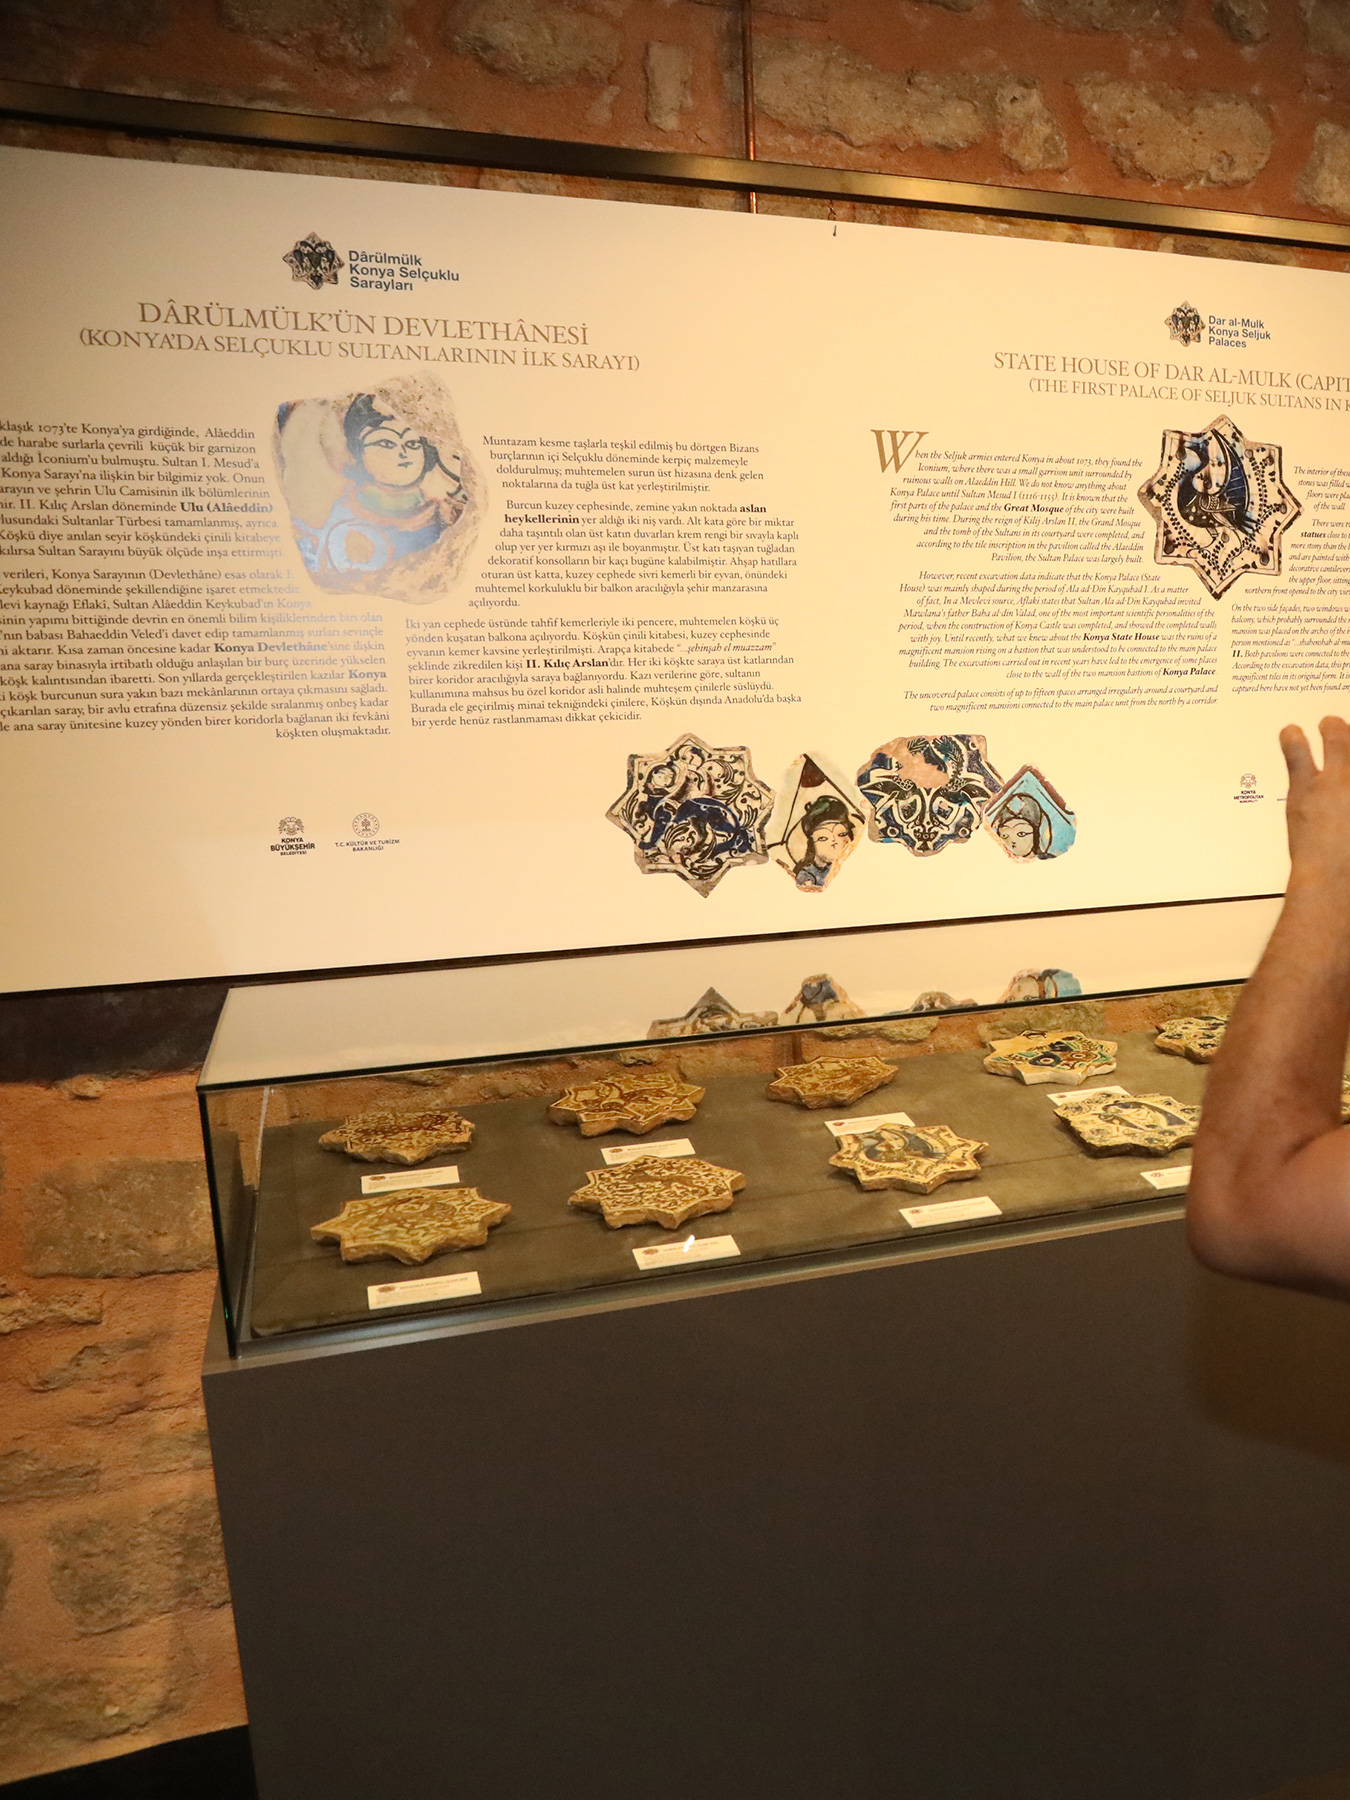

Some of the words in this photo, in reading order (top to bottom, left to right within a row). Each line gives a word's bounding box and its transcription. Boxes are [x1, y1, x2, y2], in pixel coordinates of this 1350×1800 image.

[348, 250, 422, 266] Dârülmülk
[349, 264, 396, 280] Konya
[398, 266, 460, 283] Selçuklu
[349, 276, 414, 292] Sarayları
[383, 314, 590, 346] DEVLETHÂNESİ
[1208, 314, 1226, 326] Dar
[1228, 317, 1264, 330] al-Mulk
[1208, 326, 1239, 339] Konya
[1241, 328, 1272, 342] Seljuk
[1208, 336, 1246, 348] Palaces
[214, 335, 332, 358] SELÇUKLU
[337, 342, 517, 366] SULTANLARININ
[523, 347, 558, 369] İLK
[562, 351, 641, 373] SARAYI)
[993, 352, 1057, 373] STATE
[1061, 357, 1130, 378] HOUSE
[1134, 361, 1160, 380] OF
[1165, 364, 1205, 382] DAR
[1209, 367, 1292, 390] AL-MULK
[1028, 378, 1068, 394] (THE
[1072, 381, 1118, 396] FIRST
[1120, 384, 1179, 400] PALACE
[1182, 387, 1202, 402] OF
[1204, 388, 1257, 407] SELJUK
[1260, 393, 1322, 410] SULTANS
[1325, 396, 1342, 411] IN
[37, 422, 78, 435] 1073'te
[80, 423, 135, 438] Konya'ya
[137, 425, 199, 439] girdiğinde,
[204, 427, 254, 438] Alâeddin
[0, 435, 13, 447] de
[18, 436, 58, 452] harabe
[62, 438, 104, 449] surlarla
[108, 440, 143, 452] çevrili
[150, 440, 184, 454] küçük
[188, 441, 204, 452] bir
[207, 444, 255, 455] garnizon
[482, 435, 537, 446] Muntazam
[539, 437, 570, 447] kesme
[573, 438, 608, 450] taşlarla
[610, 439, 636, 451] teşkil
[638, 440, 673, 452] edilmiş
[675, 441, 687, 451] bu
[689, 442, 726, 454] dörtgen
[729, 442, 759, 453] Bizans
[2, 451, 34, 466] aldığı
[38, 452, 98, 464] İconium'u
[100, 454, 159, 468] bulmuştu.
[161, 456, 198, 467] Sultan
[201, 456, 210, 467] I.
[213, 457, 260, 468] Mesud'a
[489, 450, 545, 461] burçlarının
[547, 451, 559, 463] içi
[561, 451, 603, 463] Selçuklu
[605, 452, 660, 463] döneminde
[662, 454, 692, 467] kerpiç
[694, 456, 748, 468] malzemeyle
[1, 467, 40, 481] Konya
[43, 468, 96, 482] Sarayı'na
[99, 469, 134, 482] ilişkin
[137, 470, 154, 481] bir
[156, 471, 202, 485] bilgimiz
[205, 472, 228, 485] yok.
[232, 472, 264, 483] Onun
[496, 464, 562, 476] doldurulmuş;
[564, 466, 626, 476] muhtemelen
[627, 469, 655, 477] surun
[656, 468, 672, 477] üst
[674, 468, 712, 478] hizasına
[713, 469, 737, 479] denk
[739, 470, 763, 482] gelen
[501, 478, 558, 488] noktalarına
[560, 479, 573, 489] da
[574, 480, 599, 492] tuğla
[600, 480, 616, 490] üst
[618, 480, 634, 490] kat
[636, 481, 710, 493] yerleştirilmiştir.
[20, 498, 36, 509] II.
[39, 499, 66, 512] Kılıç
[71, 500, 108, 510] Arslan
[111, 500, 176, 511] döneminde
[180, 501, 203, 512] Ulu
[206, 502, 274, 512] (Alâeddin)
[506, 499, 542, 509] Burcun
[544, 500, 574, 512] kuzey
[575, 501, 633, 513] cephesinde,
[635, 502, 669, 511] zemine
[671, 502, 697, 514] yakın
[699, 503, 737, 512] noktada
[739, 503, 766, 513] aslan
[1003, 503, 1029, 513] Great
[1029, 503, 1064, 515] Mosque
[504, 513, 580, 525] heykellerinin
[1082, 632, 1109, 643] Konya
[1111, 632, 1132, 640] State
[1134, 632, 1159, 640] House
[1162, 667, 1188, 678] Konya
[1189, 666, 1218, 675] Palace.
[411, 717, 426, 726] bir
[428, 716, 456, 729] yerde
[459, 712, 489, 725] henüz
[492, 714, 562, 724] rastlanmaması
[564, 712, 595, 722] dikkat
[598, 710, 641, 722] çekicidir.
[275, 727, 318, 739] köşkten
[320, 725, 390, 737] oluşmaktadır.
